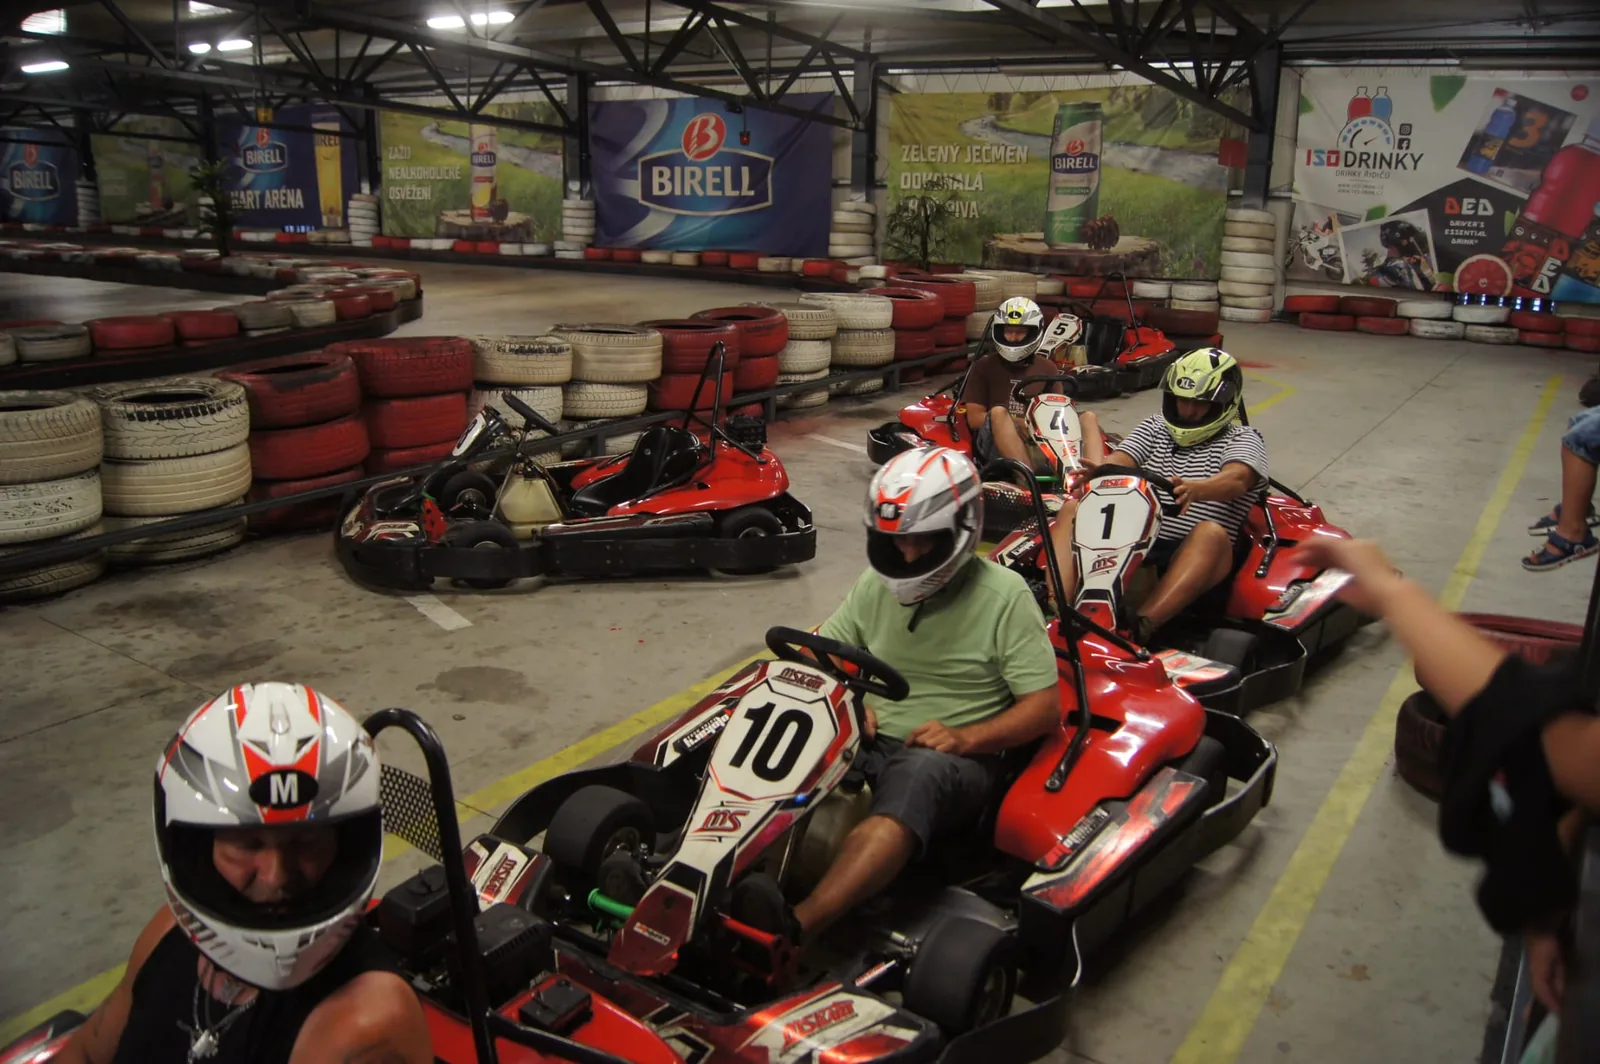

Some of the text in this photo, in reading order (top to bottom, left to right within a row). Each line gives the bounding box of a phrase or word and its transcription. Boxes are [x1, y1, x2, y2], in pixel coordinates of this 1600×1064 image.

[246, 148, 283, 164] BIRELL
[902, 143, 960, 164] ZELENÝ
[1054, 157, 1095, 169] BIRELL
[1306, 149, 1424, 170] ISO DRINKY
[13, 171, 54, 190] BIRELL
[652, 166, 755, 196] BIRELL
[264, 184, 304, 210] ARÉNA
[1053, 323, 1068, 336] 5
[1179, 378, 1191, 388] XL
[1050, 410, 1069, 435] 4
[1100, 503, 1115, 540] 1
[729, 701, 814, 782] 10
[270, 772, 299, 805] M
